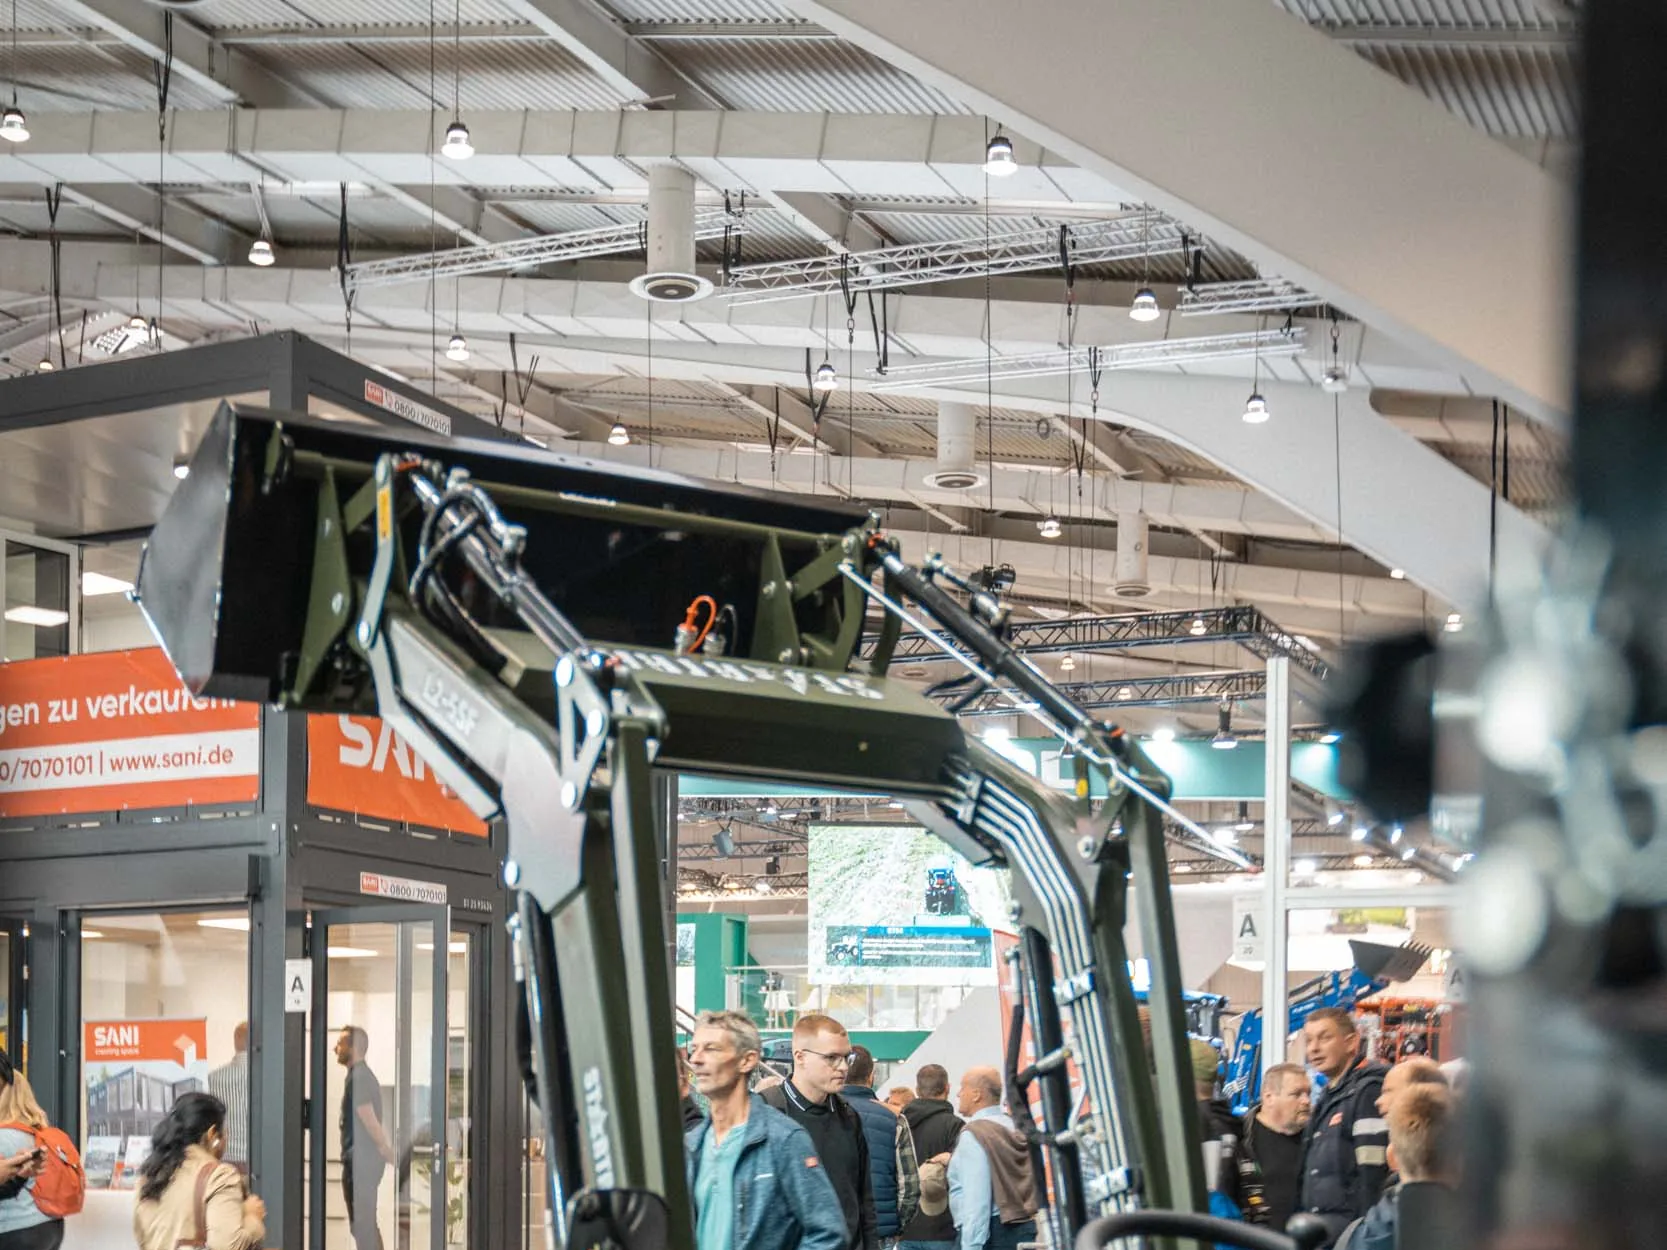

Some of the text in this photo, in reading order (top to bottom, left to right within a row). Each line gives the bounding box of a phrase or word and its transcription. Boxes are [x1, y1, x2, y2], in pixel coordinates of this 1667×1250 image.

[48, 697, 78, 723] zu
[86, 685, 236, 719] verkaufe
[110, 745, 233, 772] www.sani.de
[338, 714, 444, 786] SA
[1239, 913, 1257, 938] A
[291, 976, 304, 992] A
[94, 1024, 139, 1047] SANI
